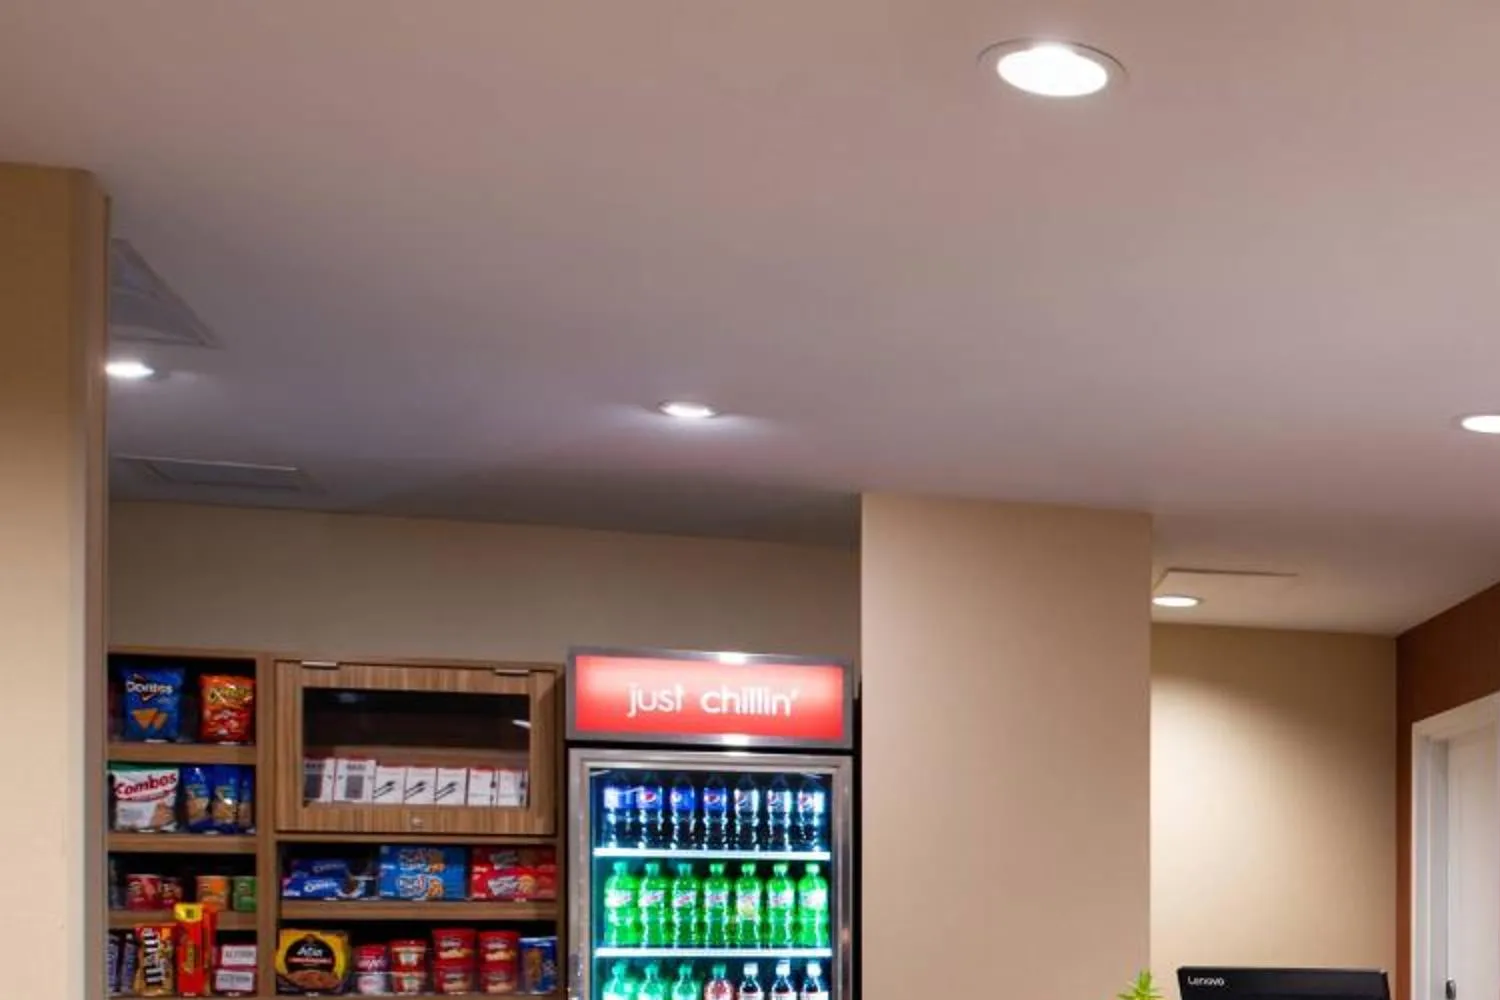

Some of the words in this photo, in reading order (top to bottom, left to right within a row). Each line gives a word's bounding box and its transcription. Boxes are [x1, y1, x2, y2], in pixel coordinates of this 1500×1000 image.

[125, 681, 173, 694] Doritos
[627, 684, 683, 717] just
[113, 773, 177, 795] Combos
[1188, 975, 1225, 987] Lenovo
